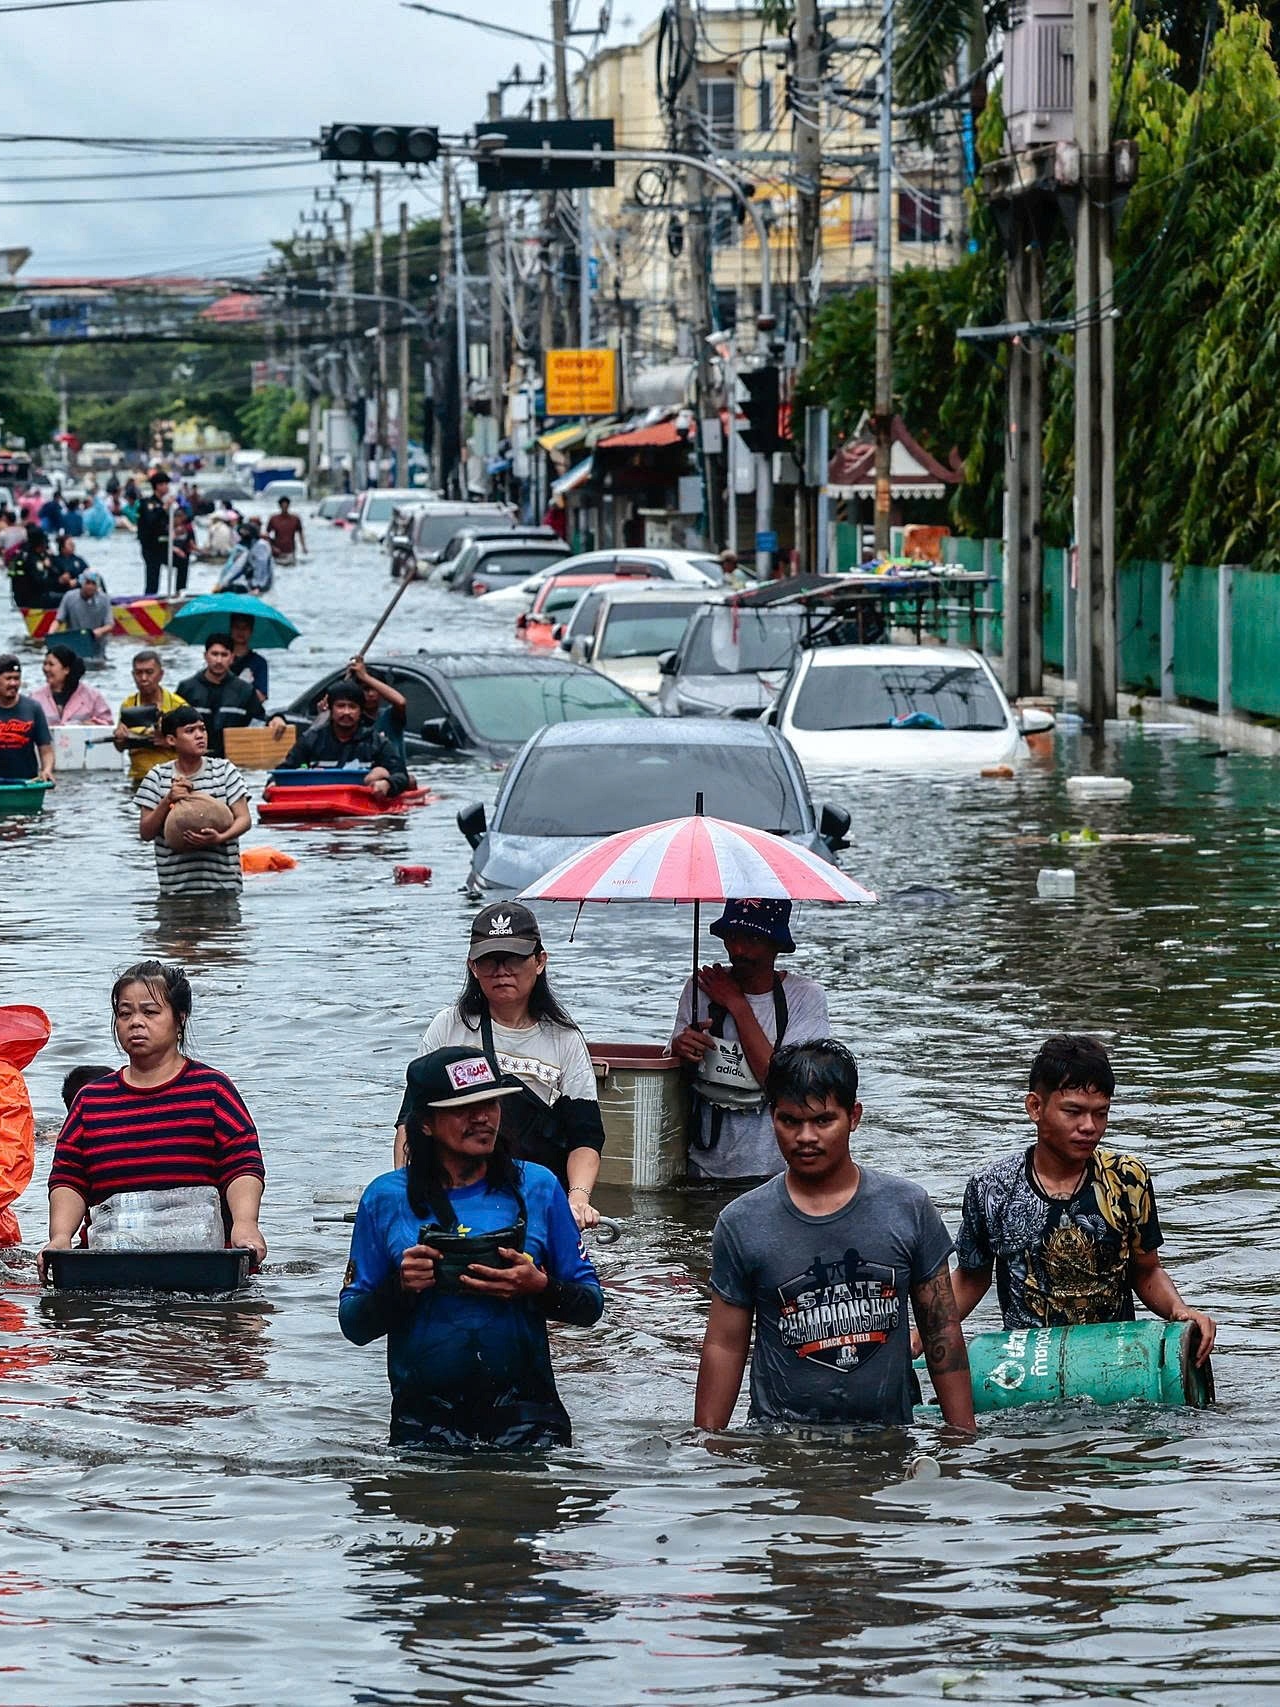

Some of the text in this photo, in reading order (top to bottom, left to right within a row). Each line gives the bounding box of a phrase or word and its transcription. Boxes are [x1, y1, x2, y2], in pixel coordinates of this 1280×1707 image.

[797, 1281, 882, 1310] STATE
[778, 1297, 900, 1346] CHAMPIONSHIPS
[819, 1333, 871, 1349] TRACK & FIELD
